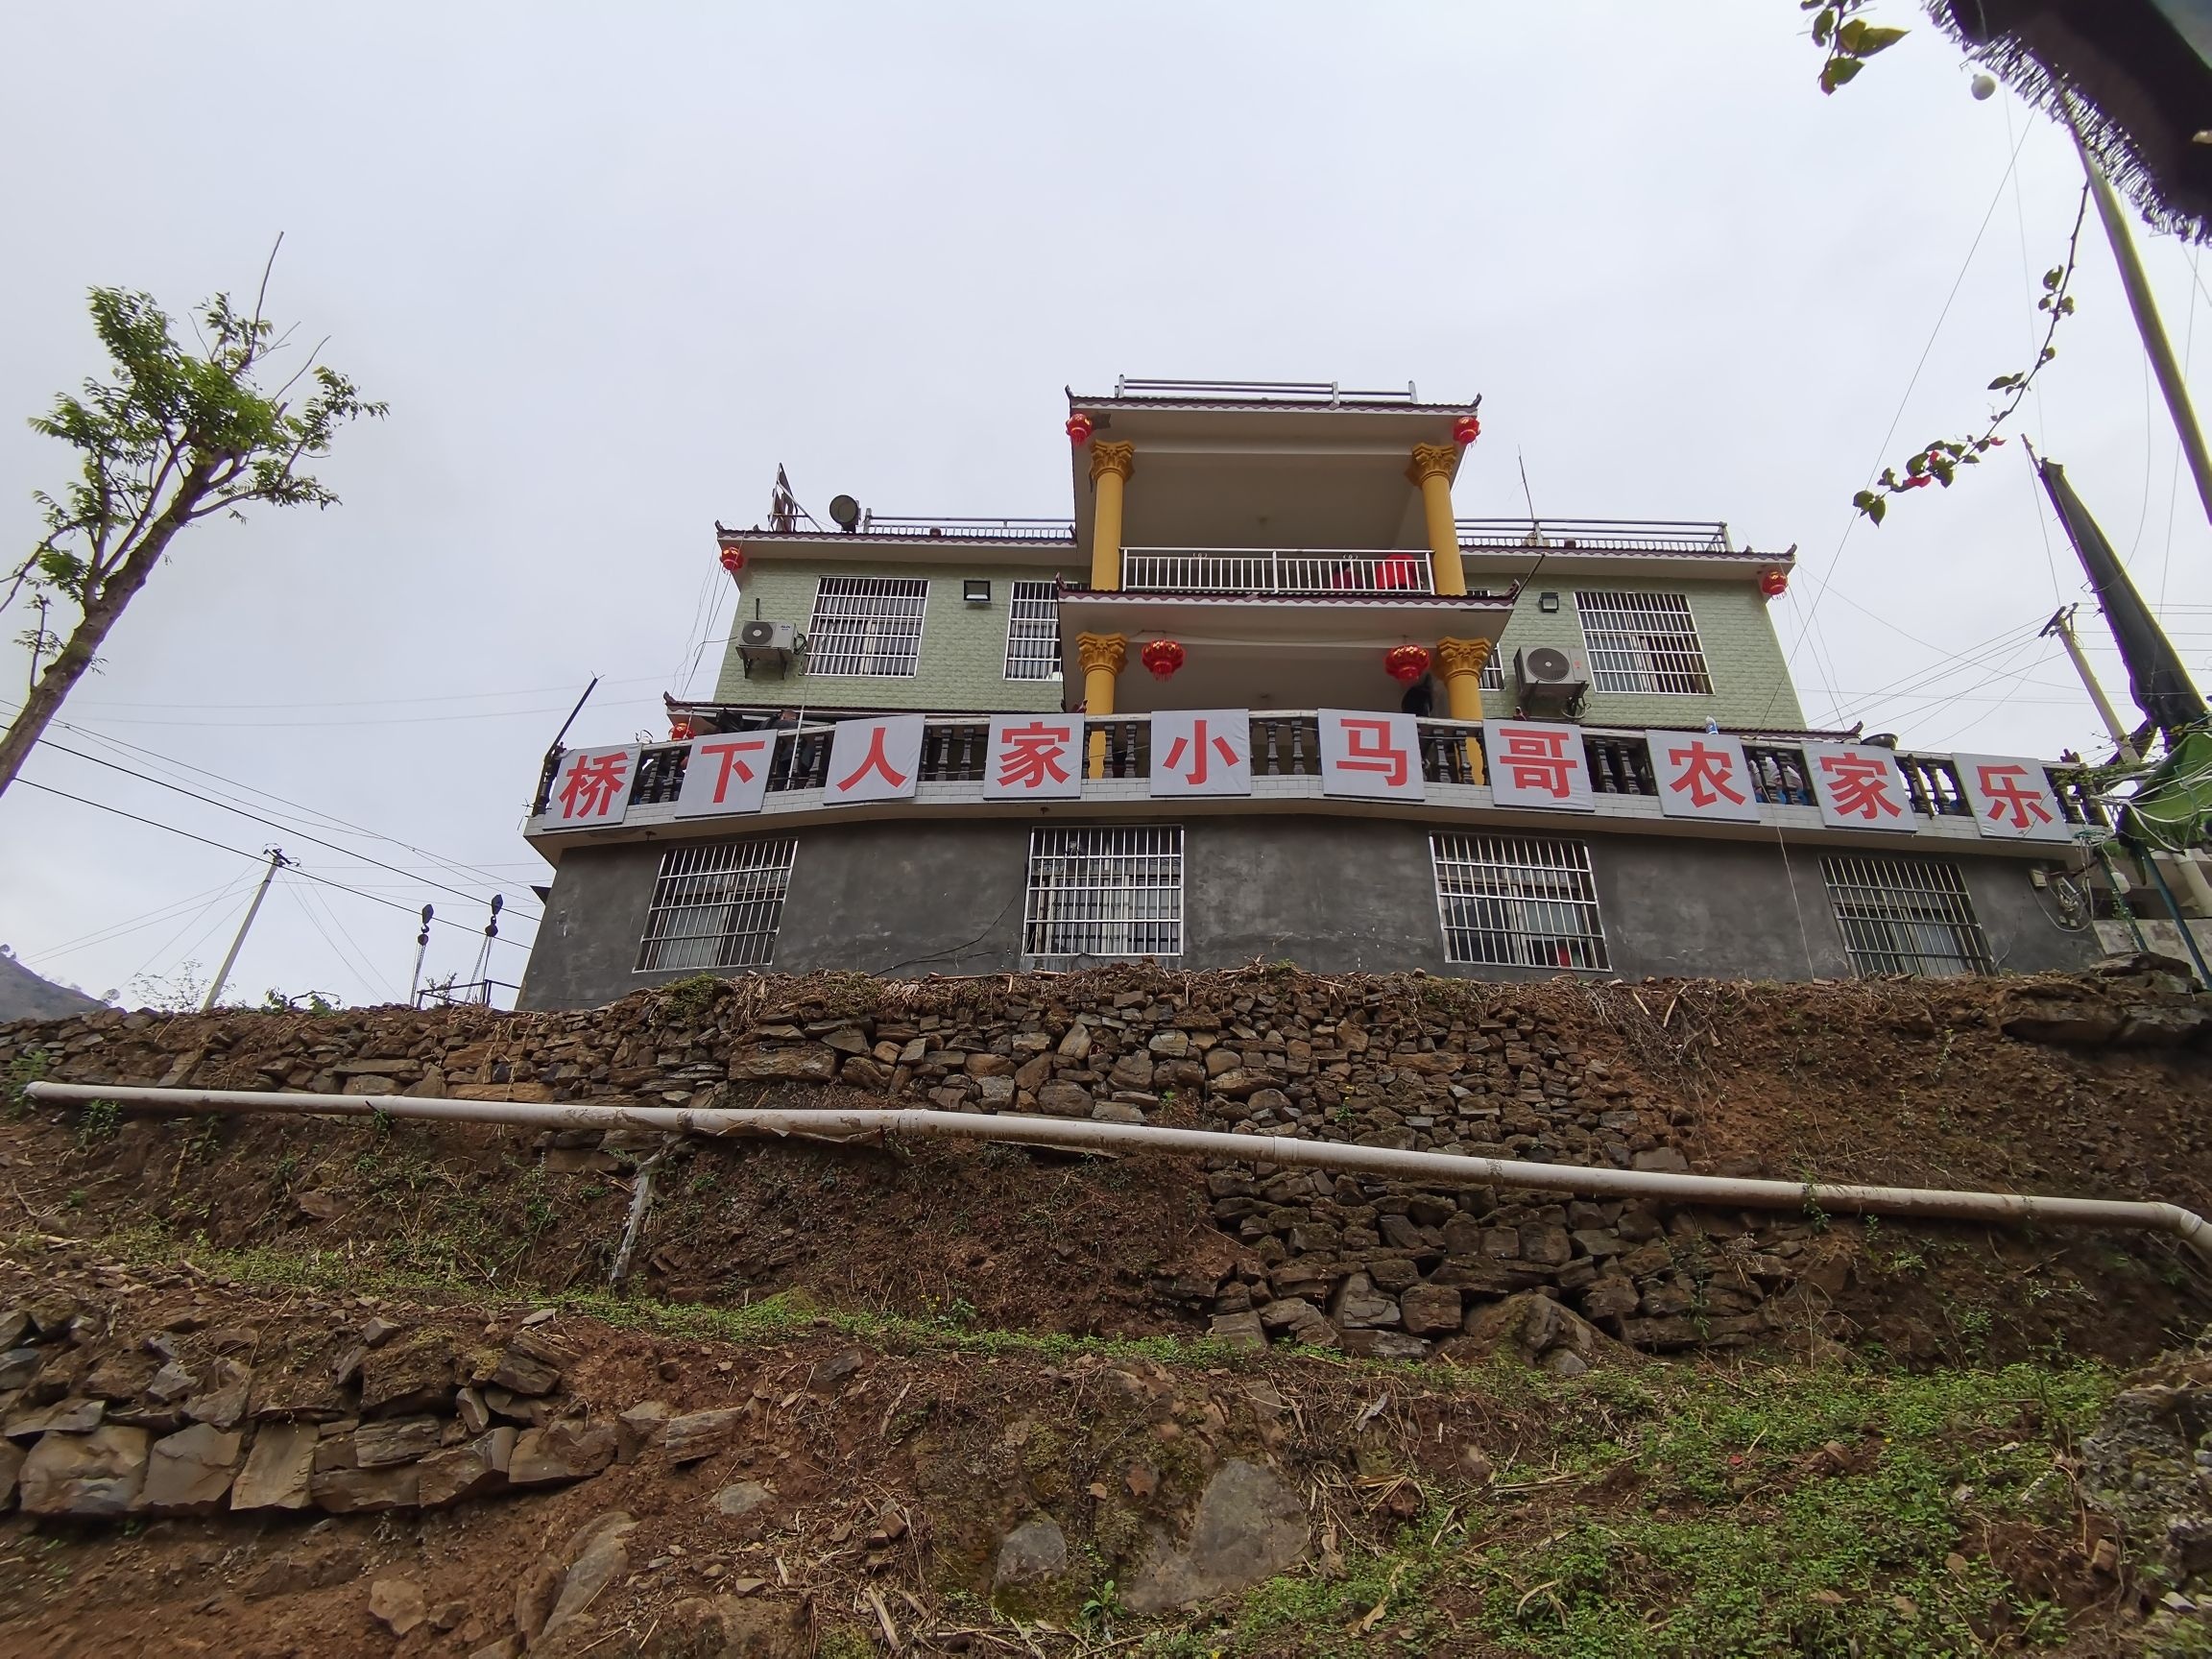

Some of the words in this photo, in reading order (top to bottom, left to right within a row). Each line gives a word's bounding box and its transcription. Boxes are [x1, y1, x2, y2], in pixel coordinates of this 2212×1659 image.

[560, 718, 2054, 830] 桥下人家小马哥农家乐
